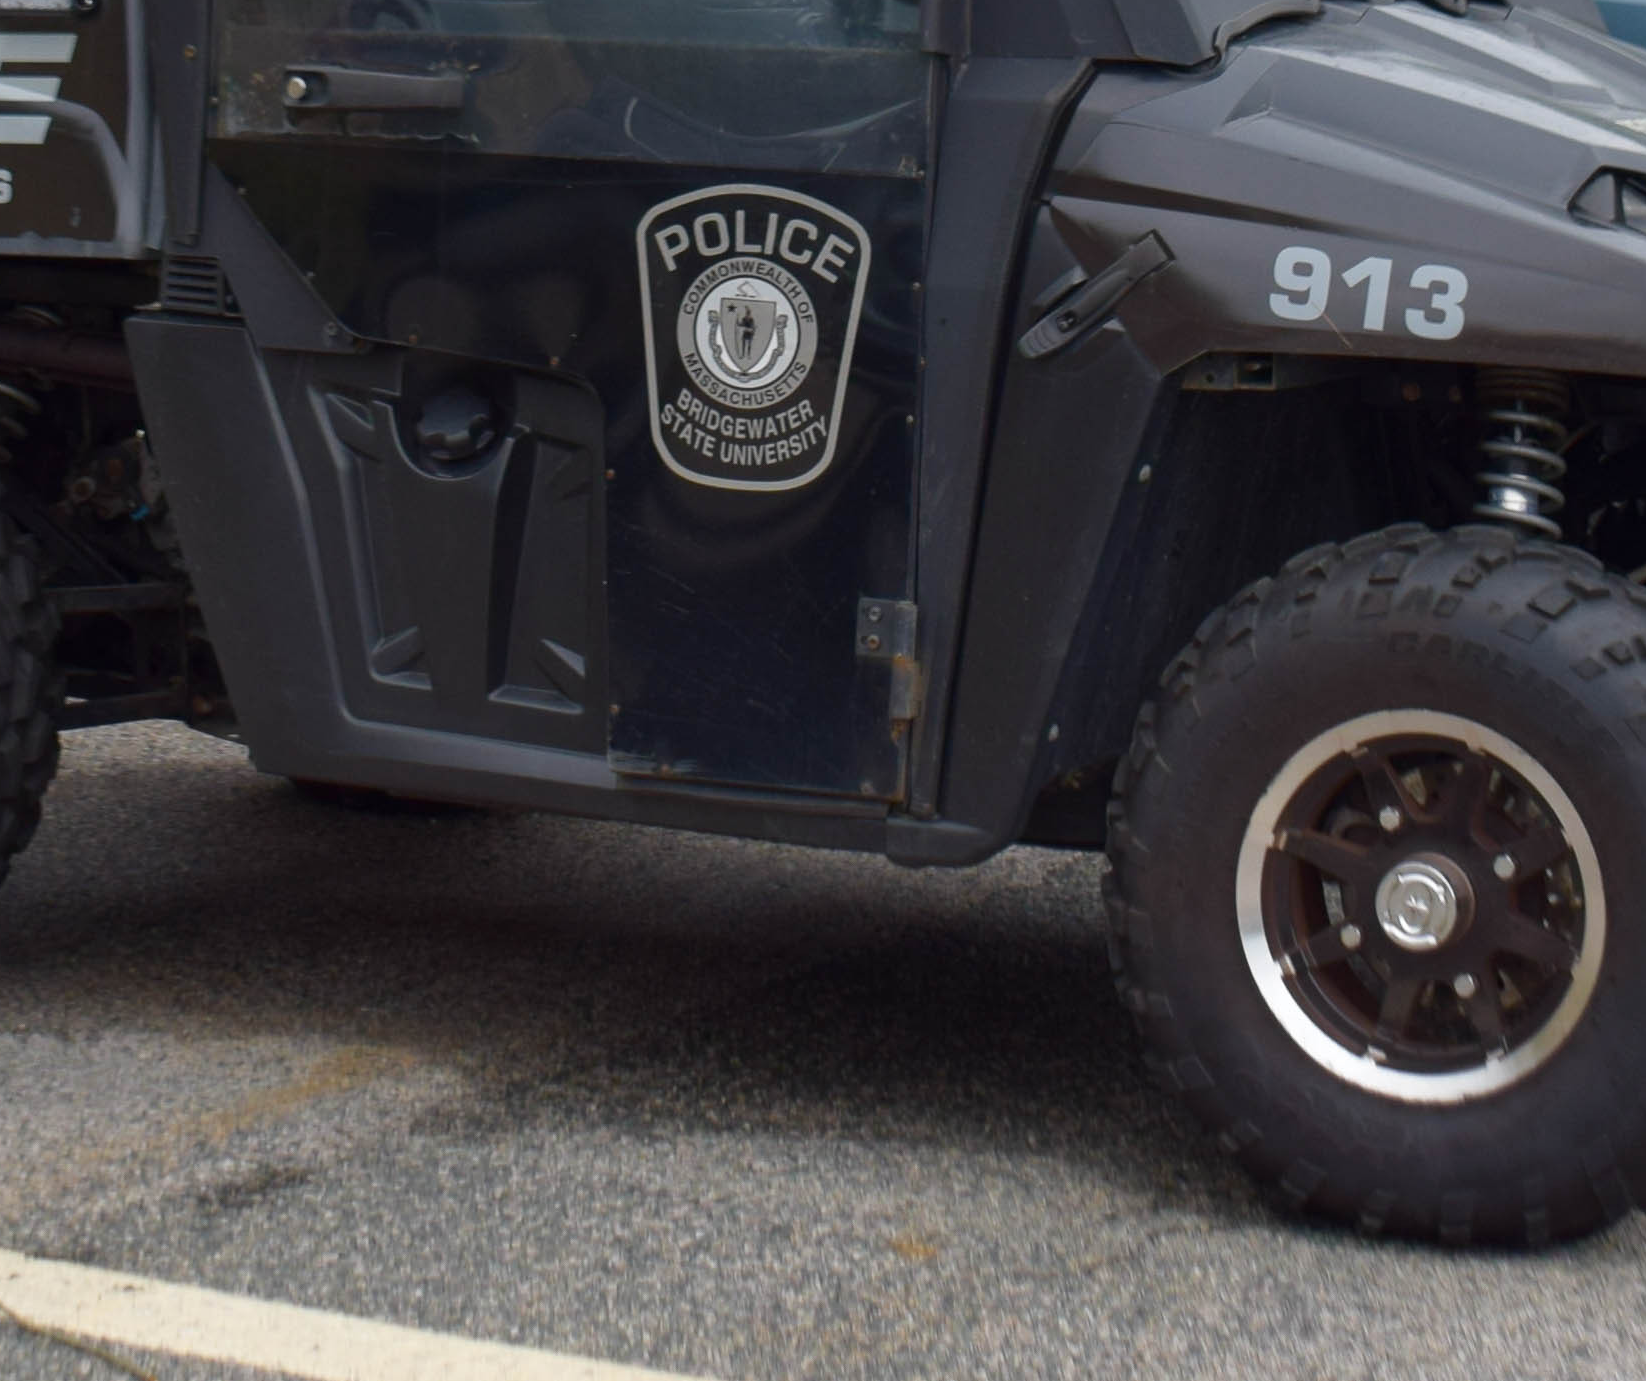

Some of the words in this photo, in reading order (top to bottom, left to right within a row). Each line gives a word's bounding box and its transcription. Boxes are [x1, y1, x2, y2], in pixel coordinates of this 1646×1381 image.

[654, 209, 856, 284] POLICE
[683, 259, 801, 316] COMMONWEALTH
[799, 301, 814, 325] OF
[1267, 245, 1470, 340] 913
[684, 352, 807, 407] MASSACHUSETTS
[660, 403, 716, 459] STATE
[719, 414, 829, 467] UNIVERSITY
[676, 387, 815, 441] BRIDGEWATER
